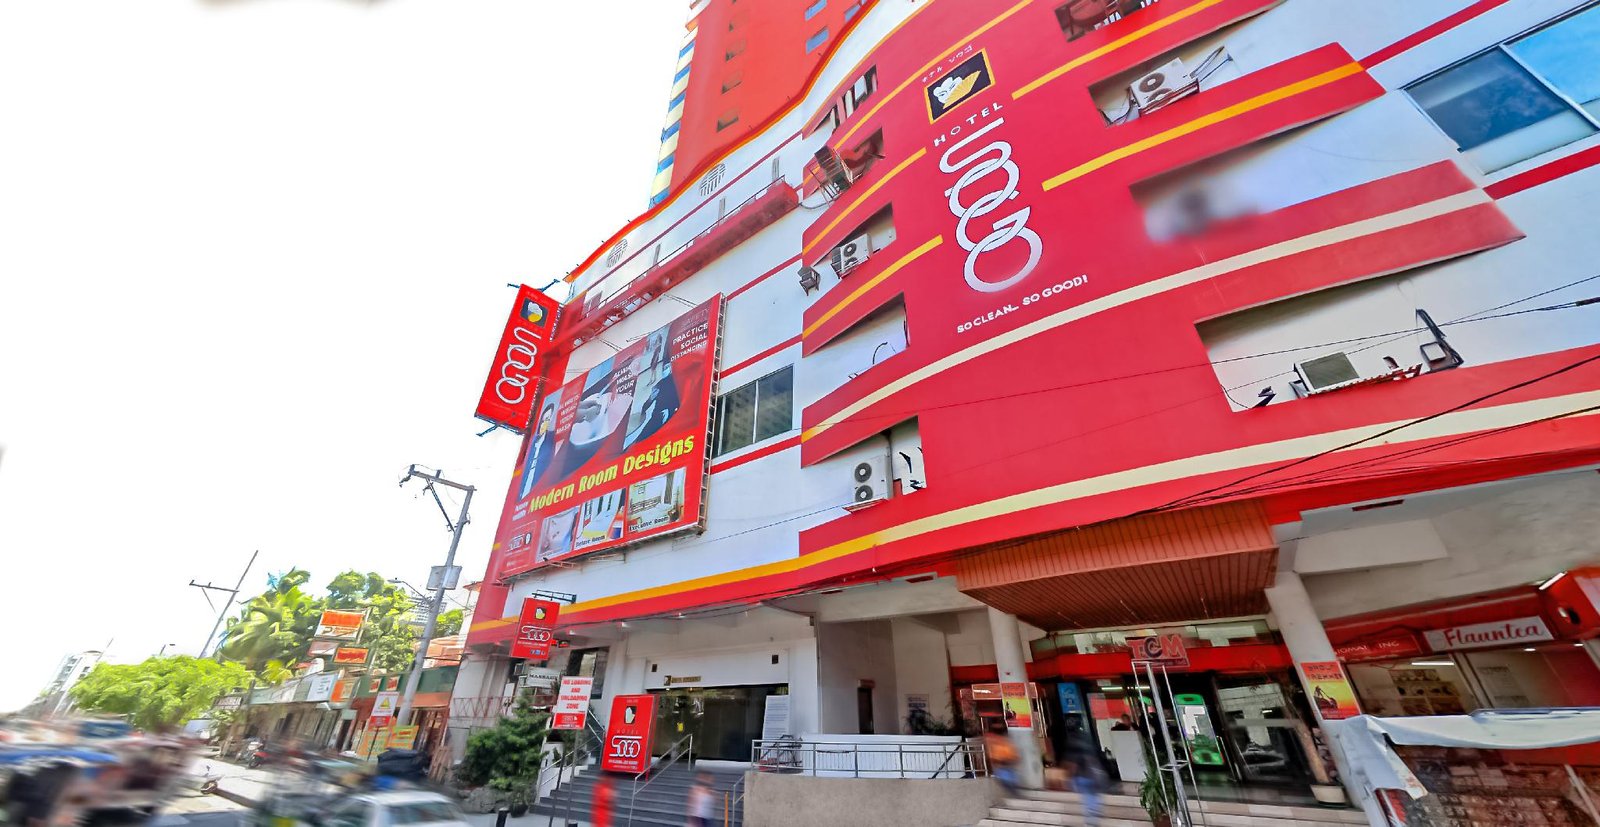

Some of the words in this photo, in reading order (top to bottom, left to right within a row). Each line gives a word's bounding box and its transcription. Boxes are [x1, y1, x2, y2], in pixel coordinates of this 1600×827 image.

[934, 102, 1004, 147] HOTEL
[939, 117, 1044, 293] SOGO
[957, 322, 973, 333] SO
[1022, 293, 1040, 305] SO
[1042, 275, 1088, 297] GOOD!
[672, 322, 708, 345] PRACTICE
[680, 333, 708, 350] SOCIAL
[670, 341, 707, 362] DISTANCING
[495, 326, 542, 404] SOGO
[528, 484, 574, 513] Modern
[578, 464, 617, 492] Room
[623, 434, 695, 475] Designs
[519, 625, 551, 642] SOGO
[1443, 623, 1541, 648] Flauntea
[1126, 634, 1186, 660] TCM
[609, 735, 642, 758] SOGO
